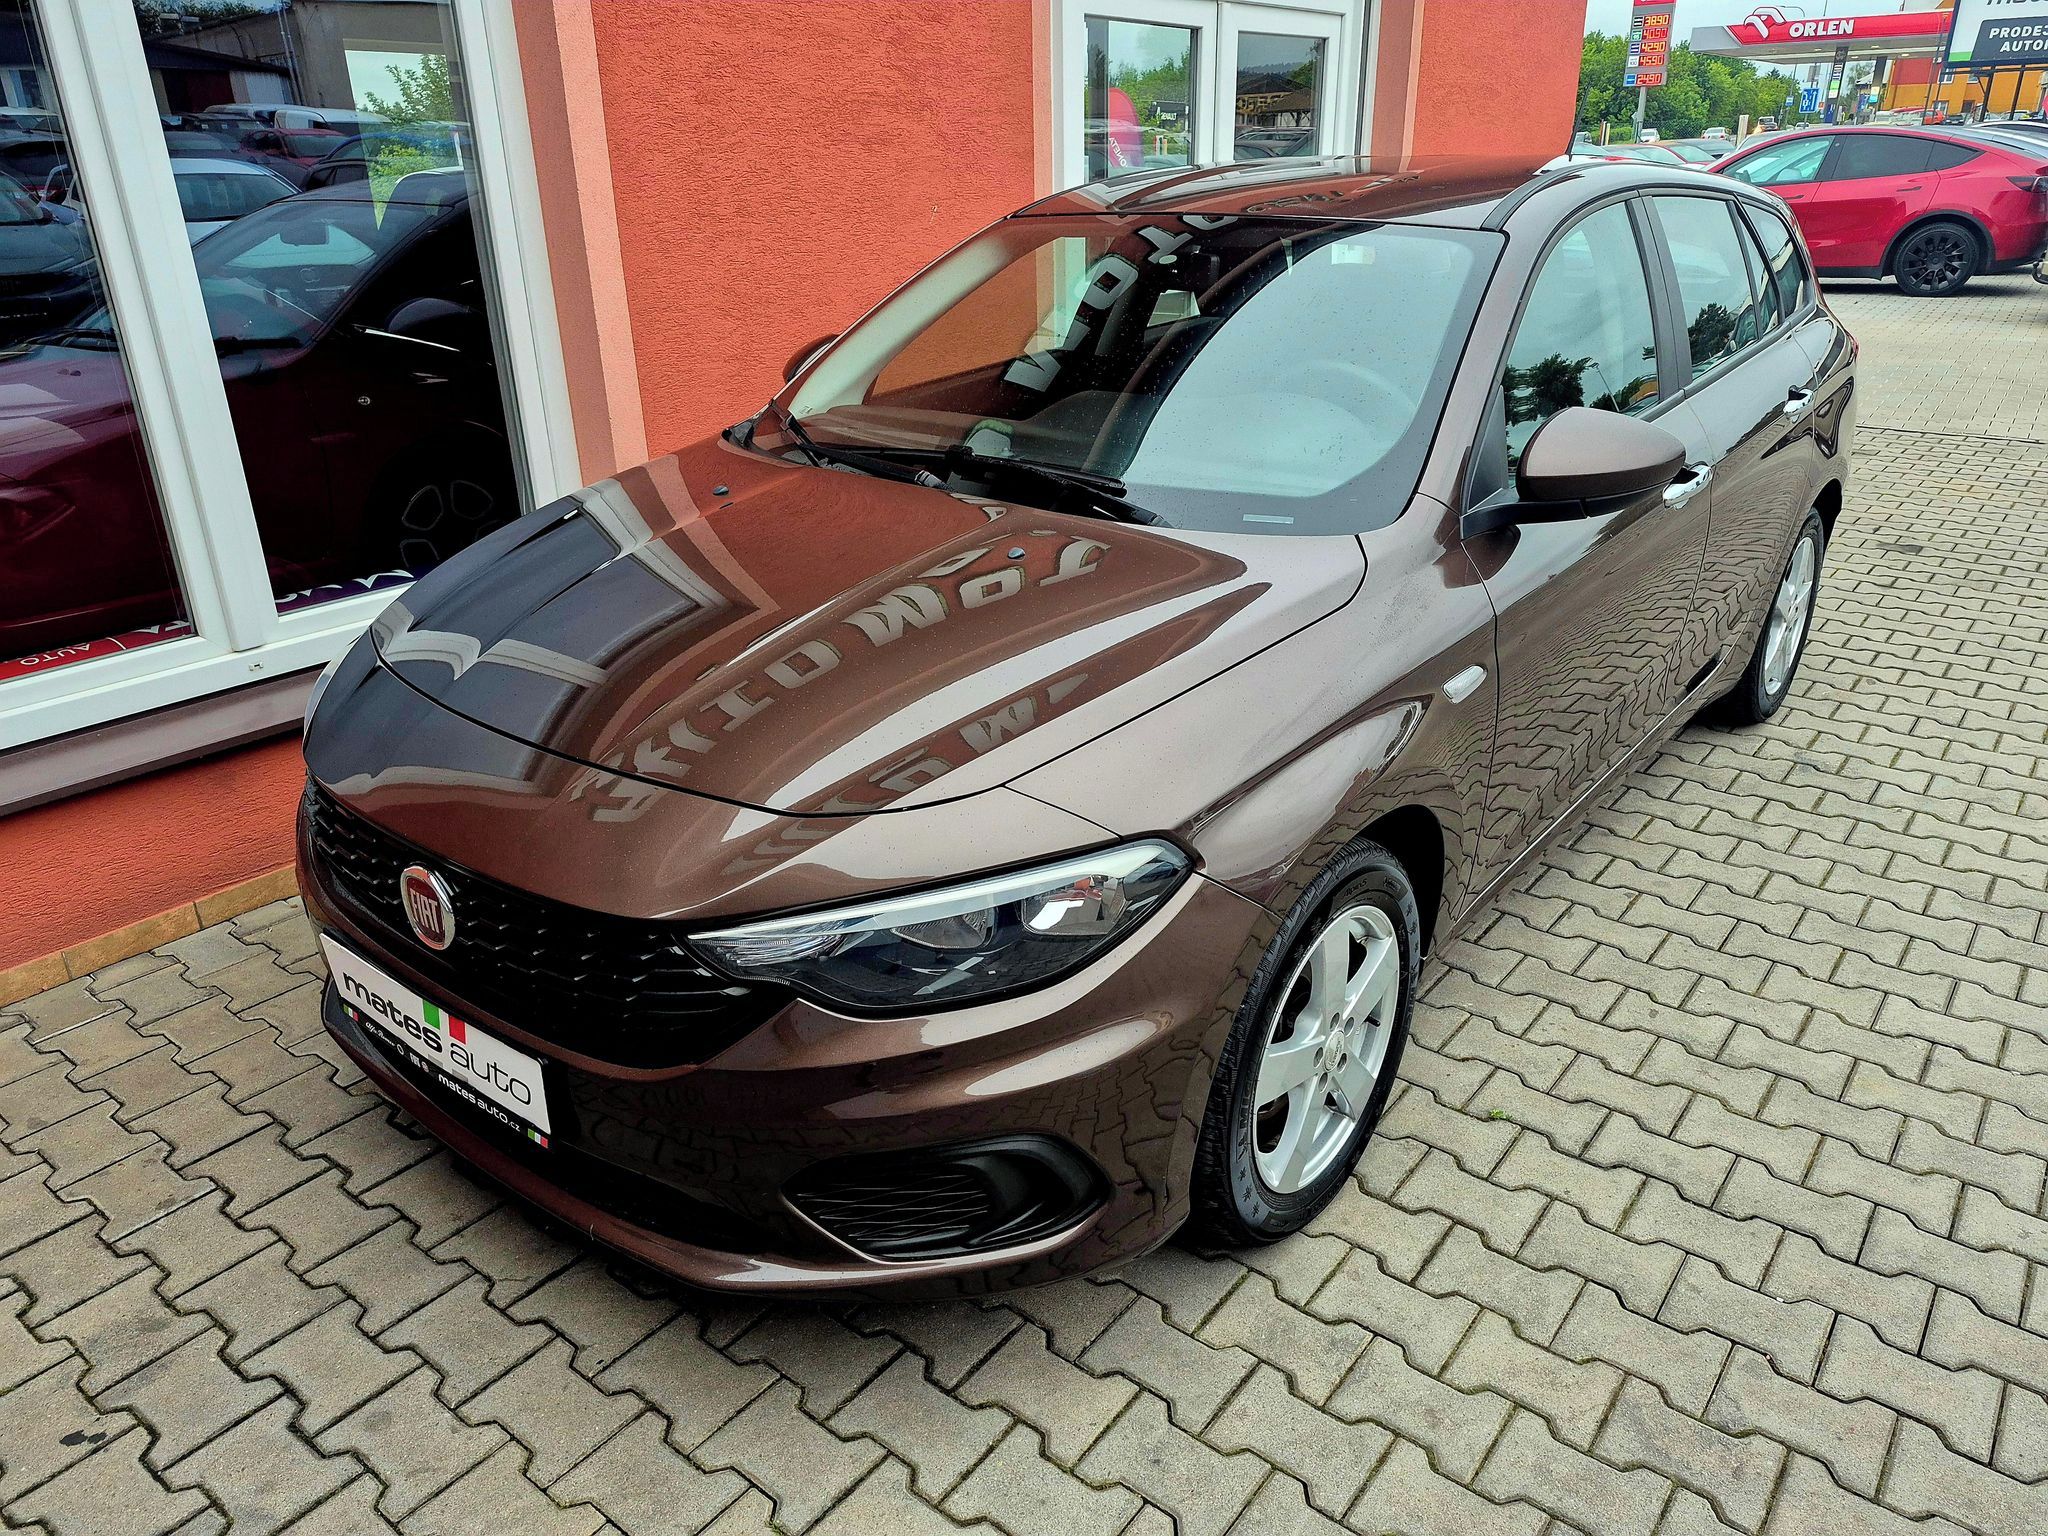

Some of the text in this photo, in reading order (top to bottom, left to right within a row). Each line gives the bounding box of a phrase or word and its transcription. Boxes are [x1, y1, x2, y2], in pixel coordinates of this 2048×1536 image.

[1789, 20, 1854, 38] ORLEN
[1641, 41, 1666, 52] 4290
[410, 887, 440, 933] FIAT
[343, 971, 531, 1106] mates auto
